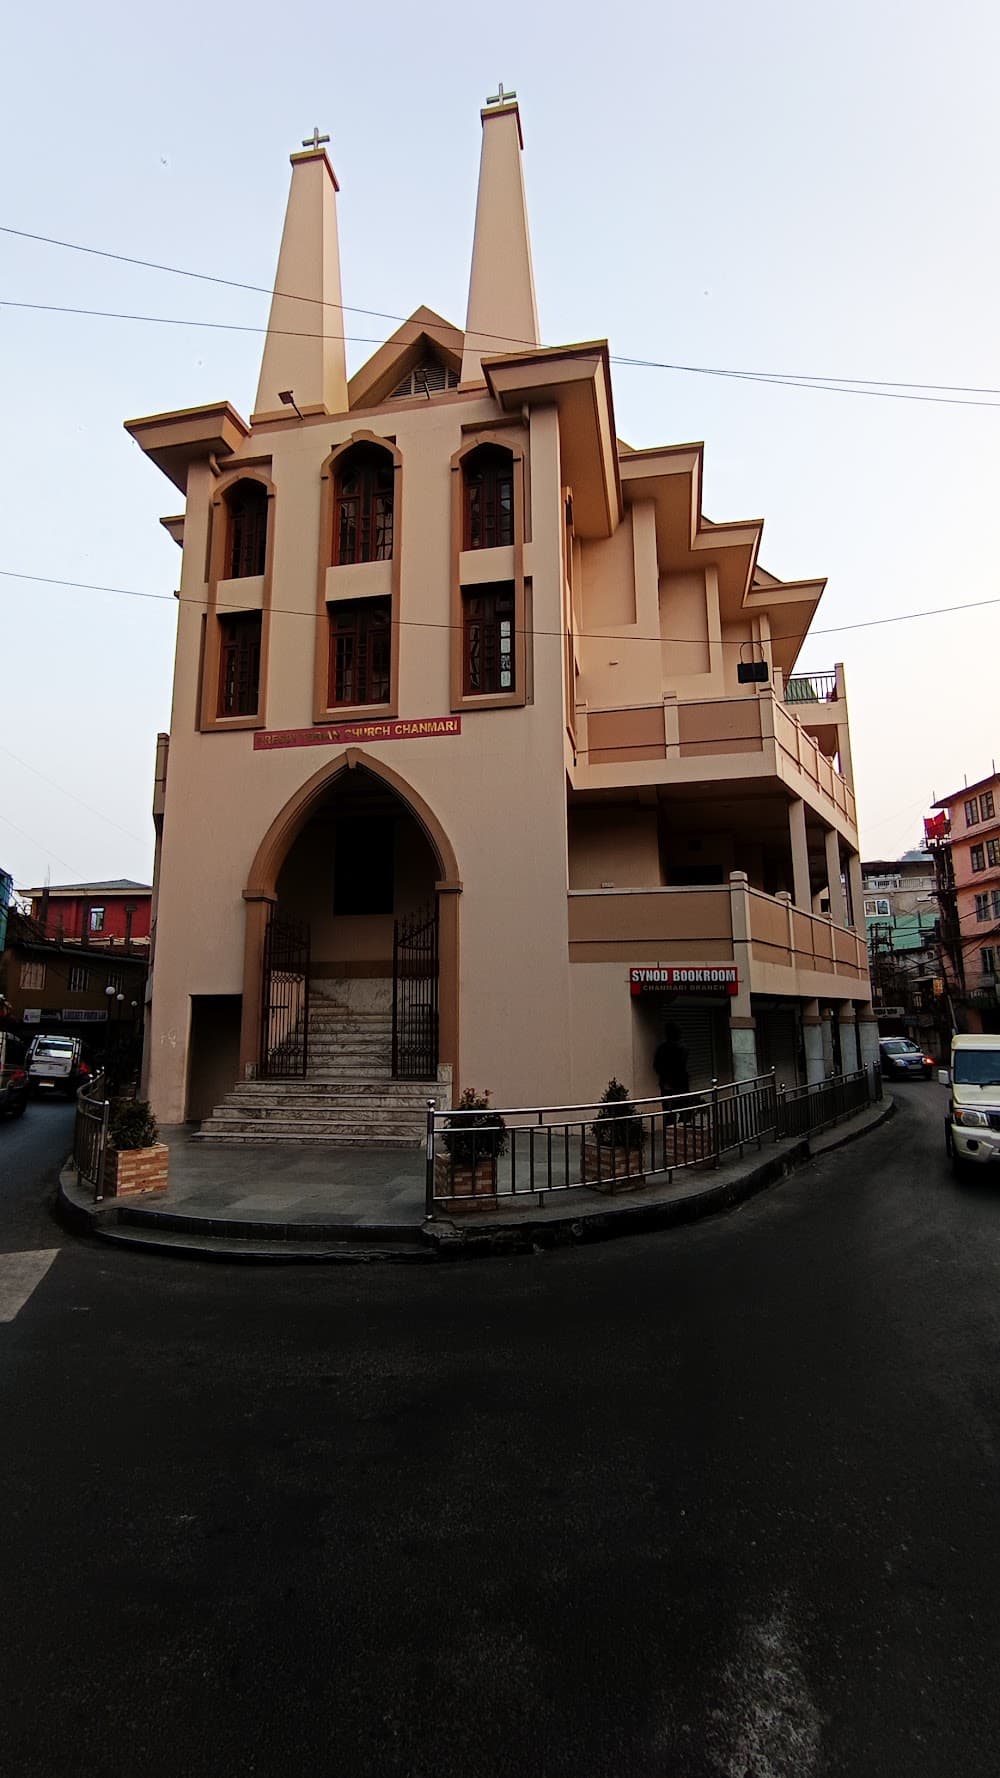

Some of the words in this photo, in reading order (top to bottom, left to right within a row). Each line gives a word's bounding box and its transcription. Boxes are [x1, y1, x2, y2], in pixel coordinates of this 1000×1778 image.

[257, 728, 341, 746] PRESBYERIAN
[344, 725, 390, 738] CHURCH
[394, 720, 458, 735] CHANMARI
[631, 969, 669, 982] SYNOD
[672, 969, 736, 982] BOOKROOM
